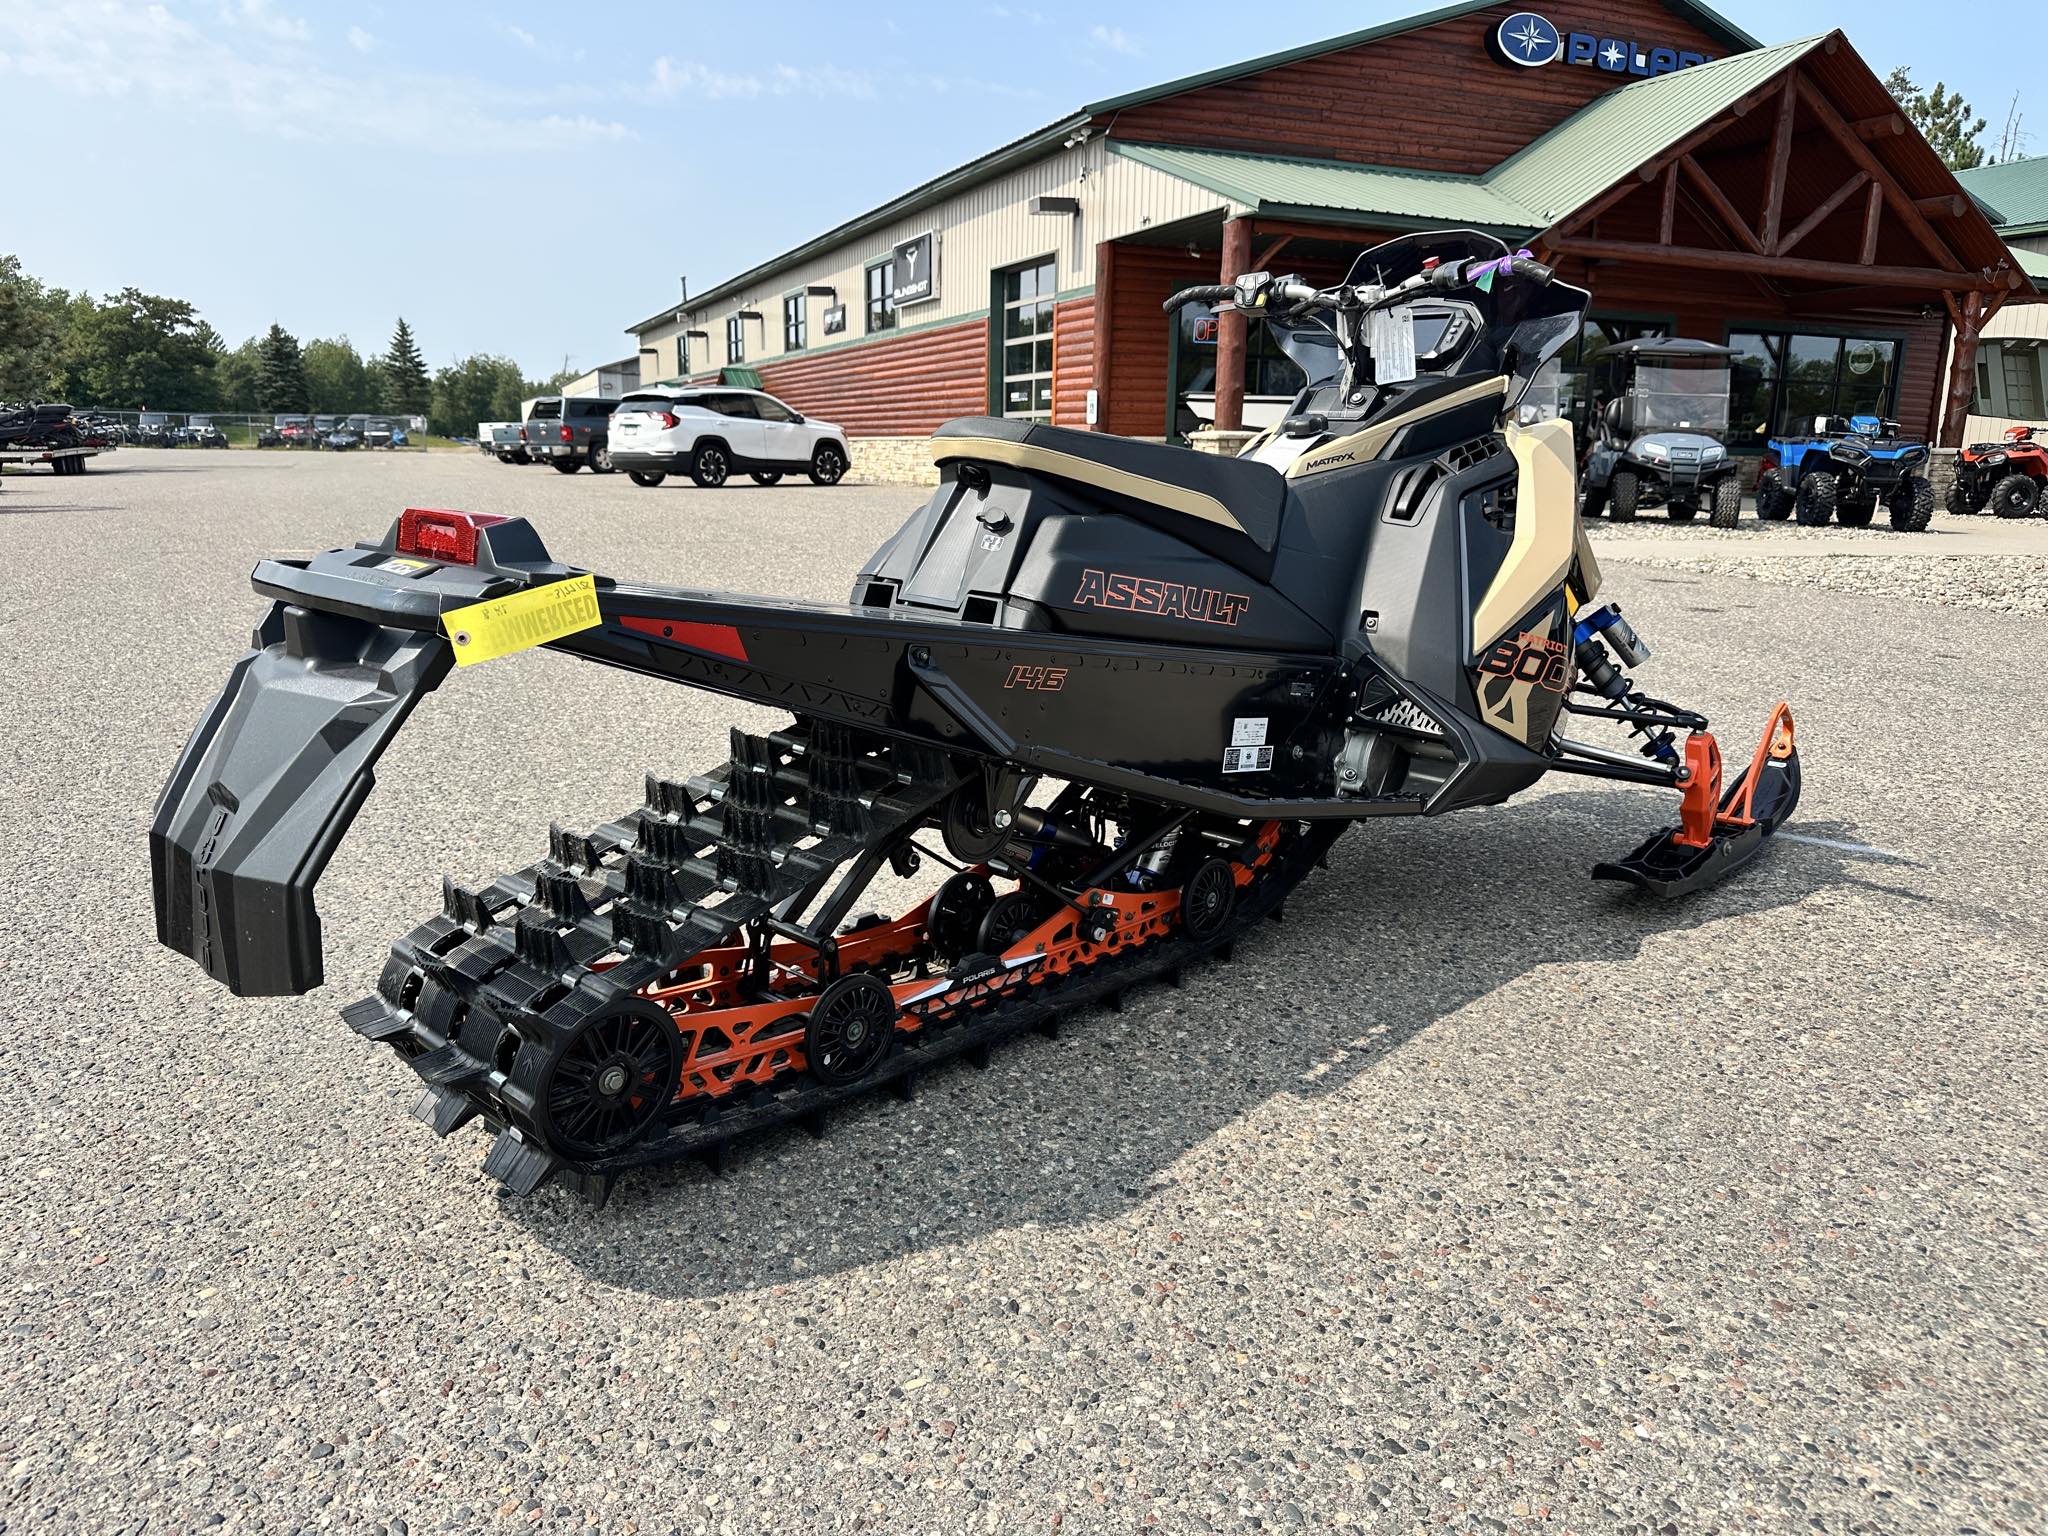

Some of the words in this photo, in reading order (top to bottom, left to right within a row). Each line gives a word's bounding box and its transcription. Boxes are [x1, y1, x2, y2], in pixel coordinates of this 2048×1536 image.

[1567, 33, 1713, 77] POLA
[1196, 320, 1218, 341] OP
[1306, 452, 1356, 471] MATRYX
[1073, 569, 1250, 626] ASSAULT
[1004, 665, 1068, 691] 146
[1477, 639, 1569, 692] 800
[962, 967, 996, 984] POLARIS
